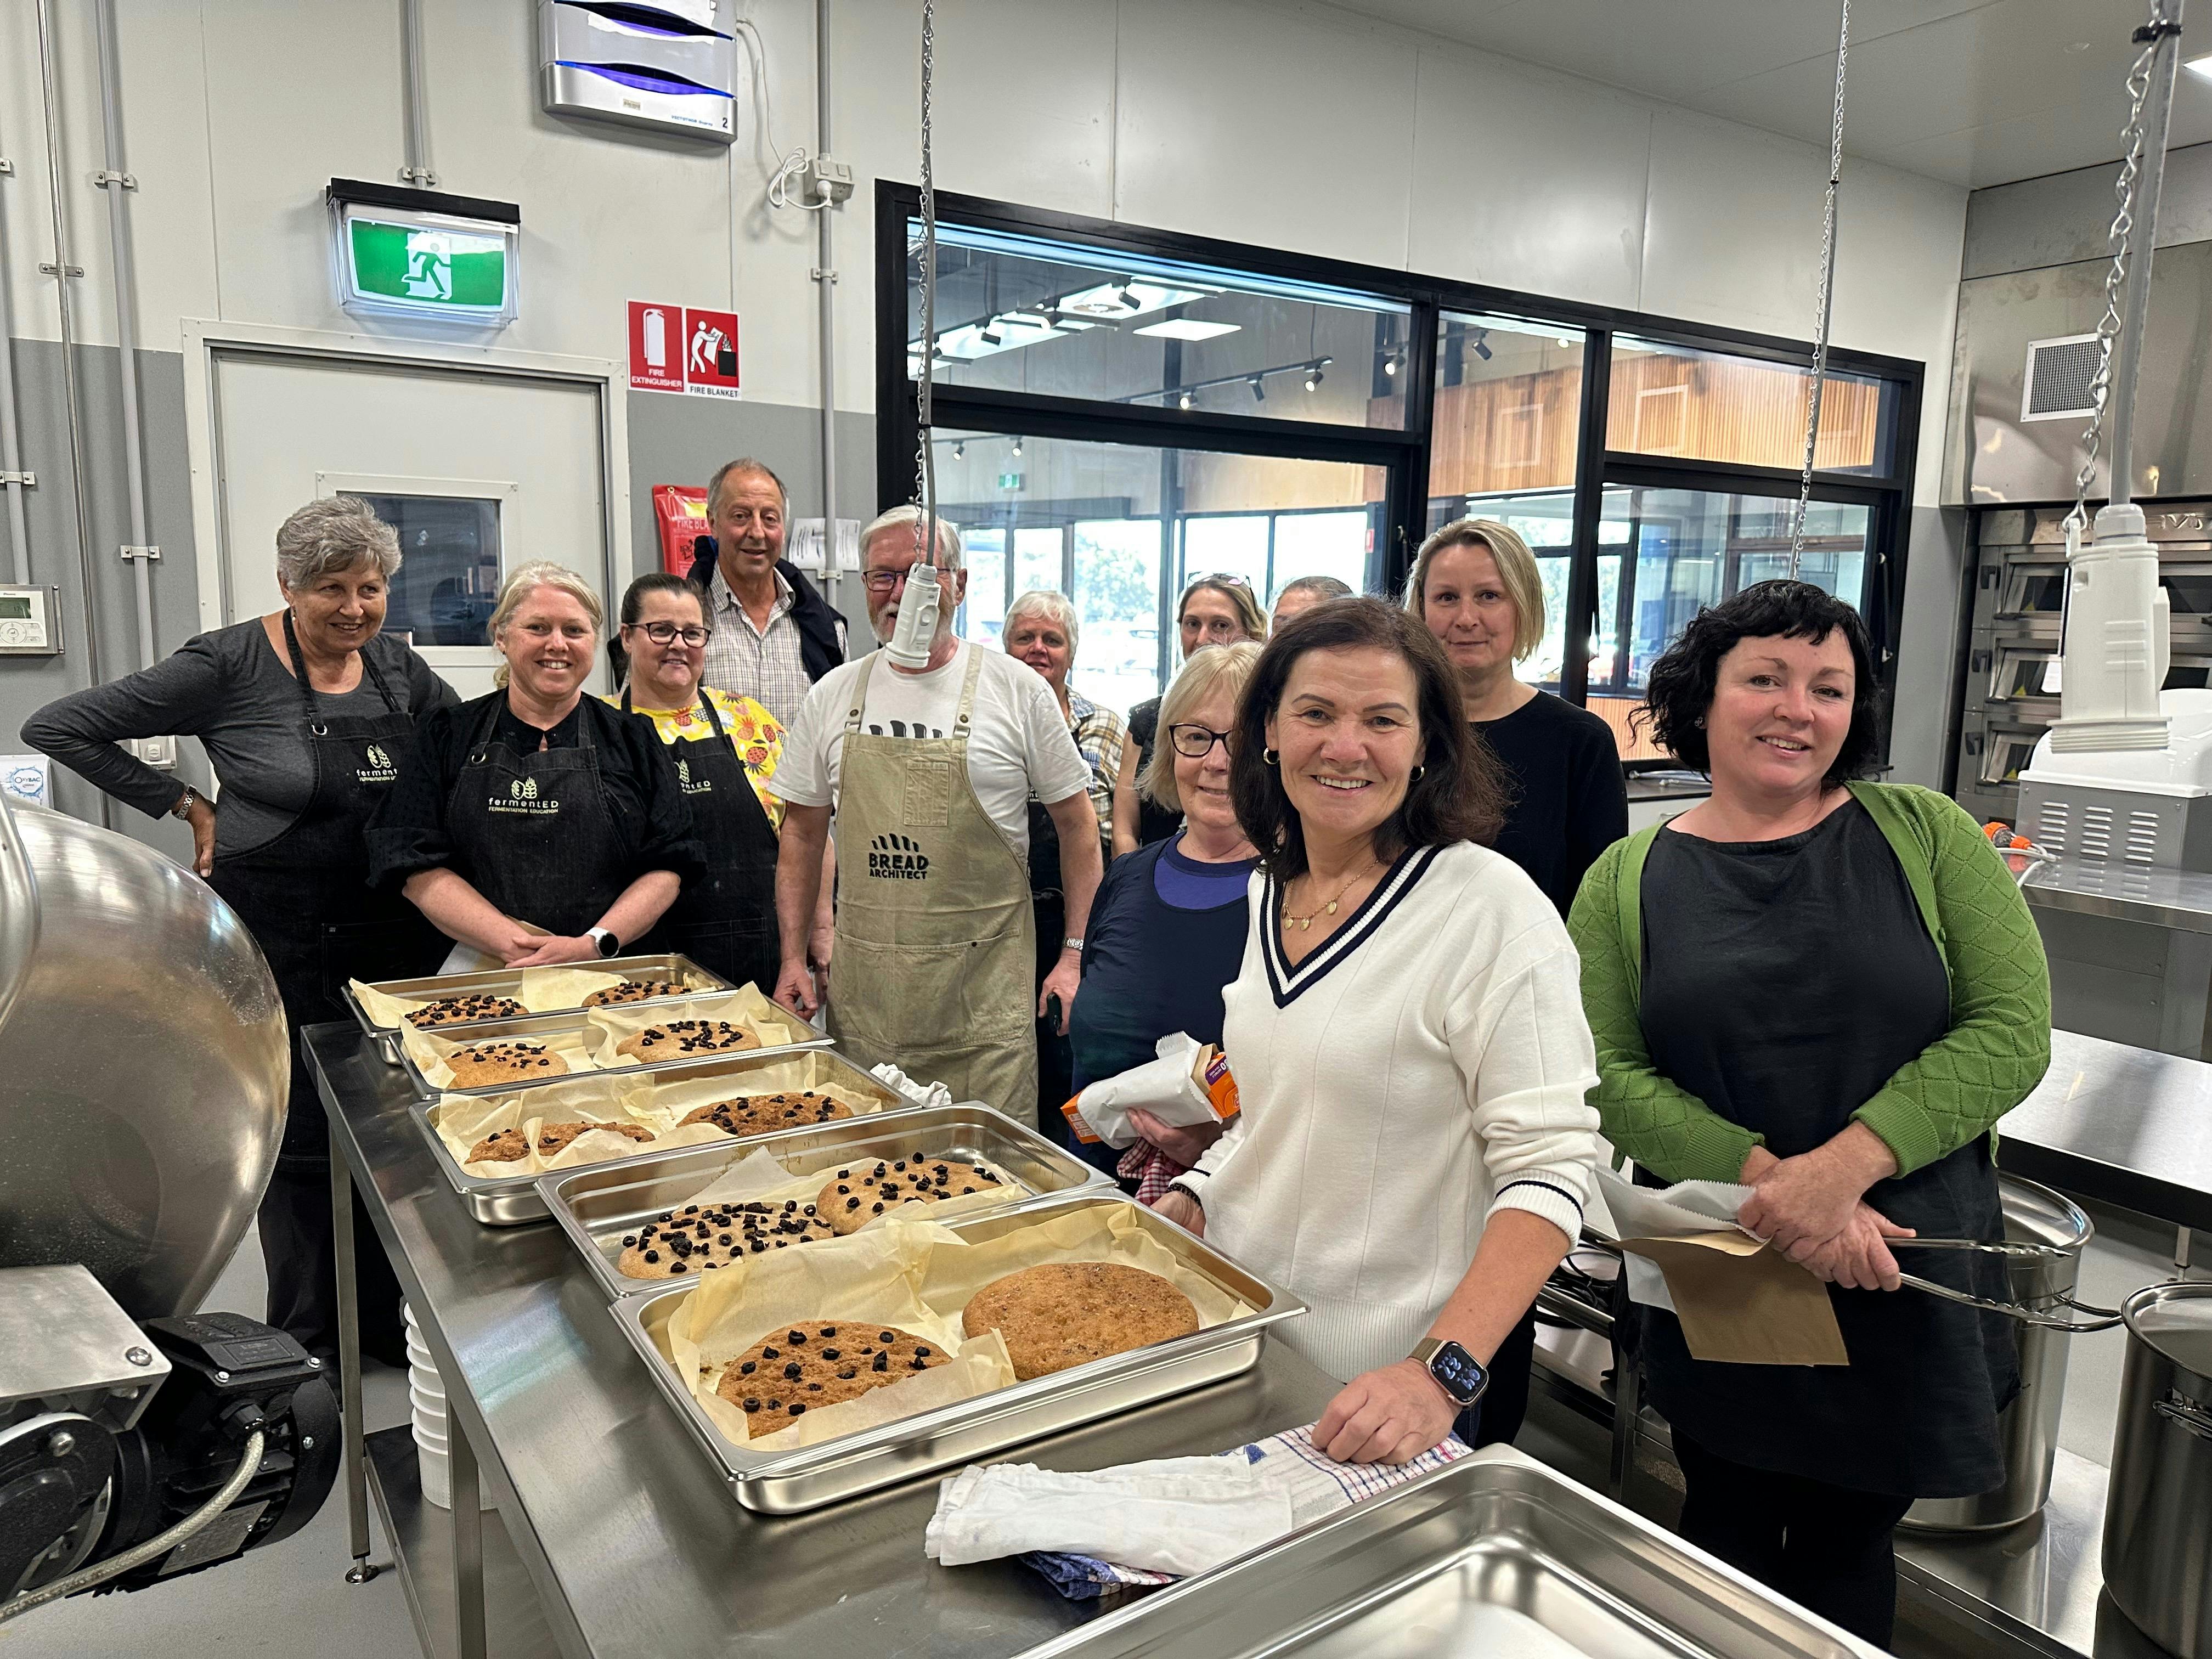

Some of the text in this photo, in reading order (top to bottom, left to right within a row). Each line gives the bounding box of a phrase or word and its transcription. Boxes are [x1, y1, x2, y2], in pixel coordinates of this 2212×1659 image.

[722, 117, 728, 128] 2
[648, 368, 665, 377] FIRE
[631, 376, 682, 387] EXTINGUISHER
[690, 386, 738, 398] FIRE BLANKET
[676, 519, 694, 529] FIRE
[356, 768, 398, 776] ferment
[488, 797, 559, 808] fermentED
[868, 852, 929, 870] BREAD
[869, 868, 927, 879] ARCHITECT
